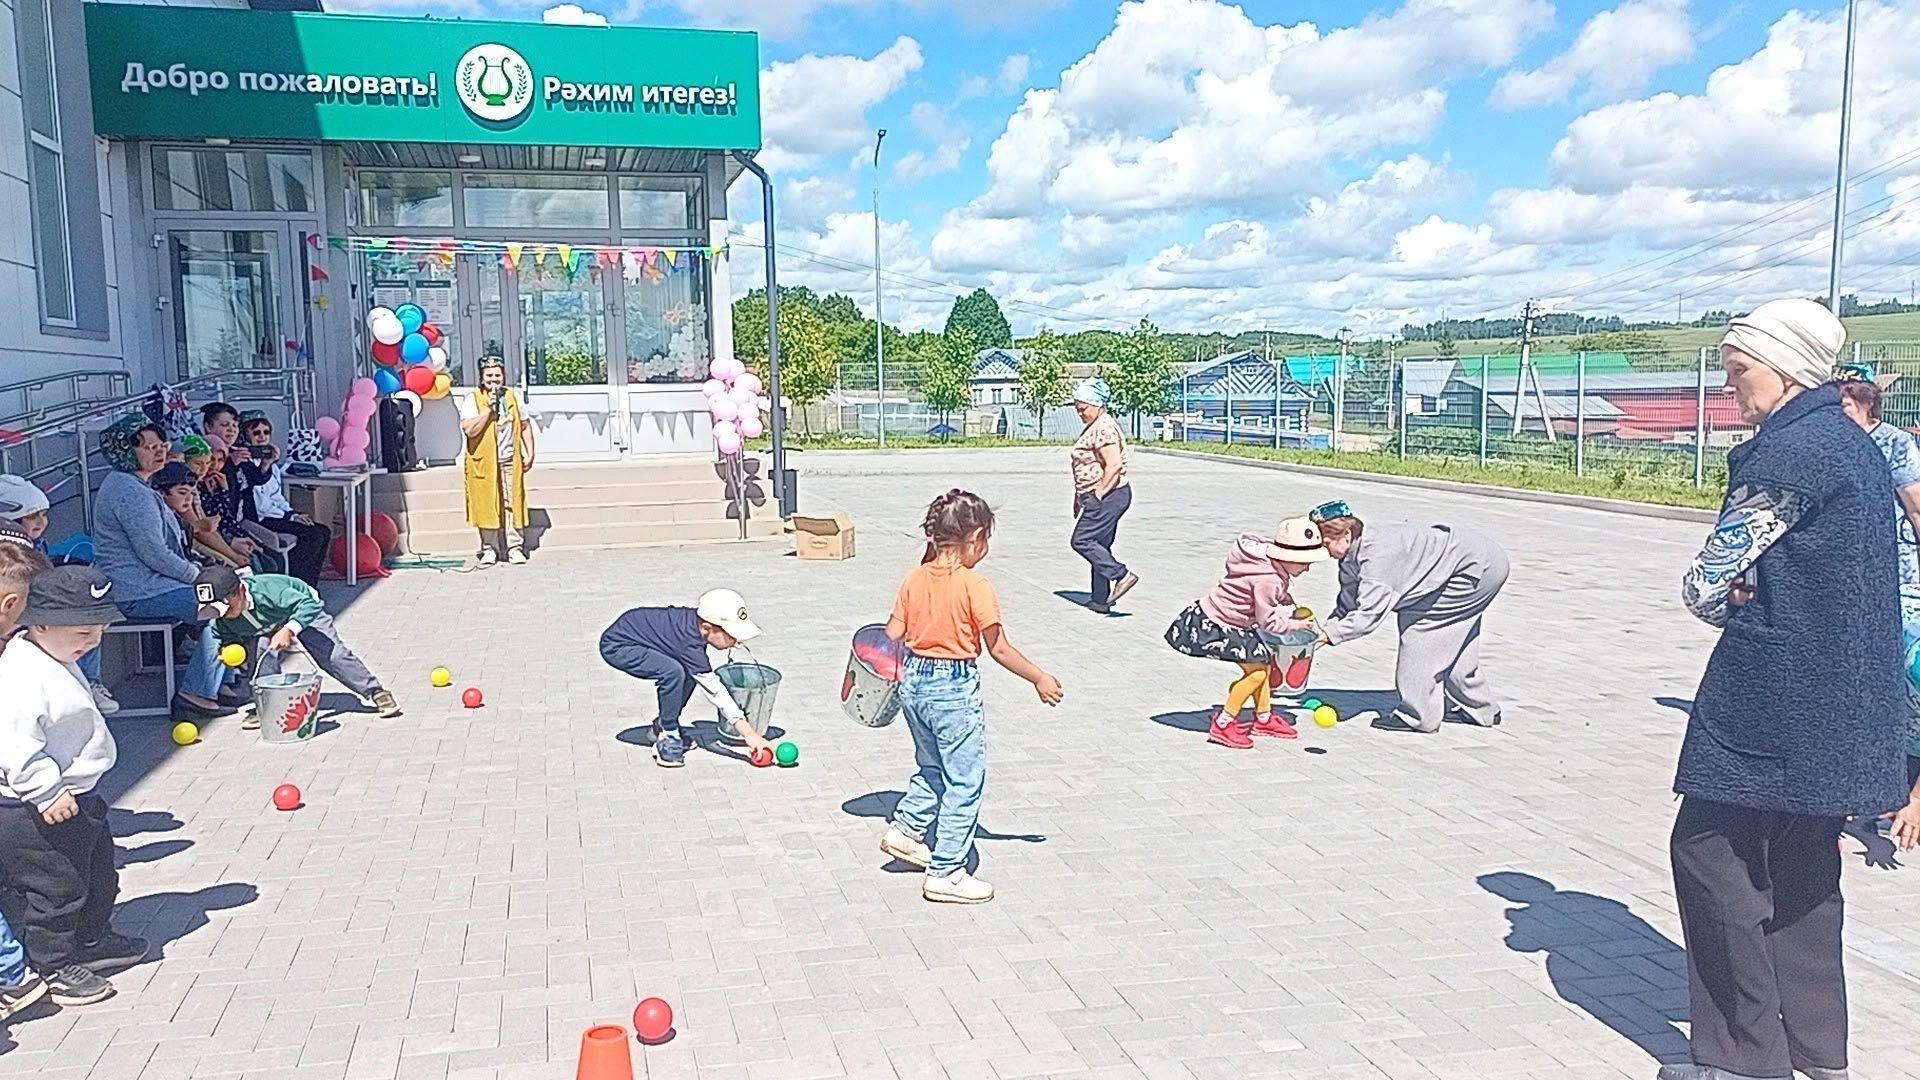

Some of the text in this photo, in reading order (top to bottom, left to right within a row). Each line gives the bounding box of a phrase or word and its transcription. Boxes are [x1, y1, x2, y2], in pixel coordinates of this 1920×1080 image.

[121, 62, 437, 96] Добро пожаловать!
[543, 76, 736, 106] Рәхим итегез!
